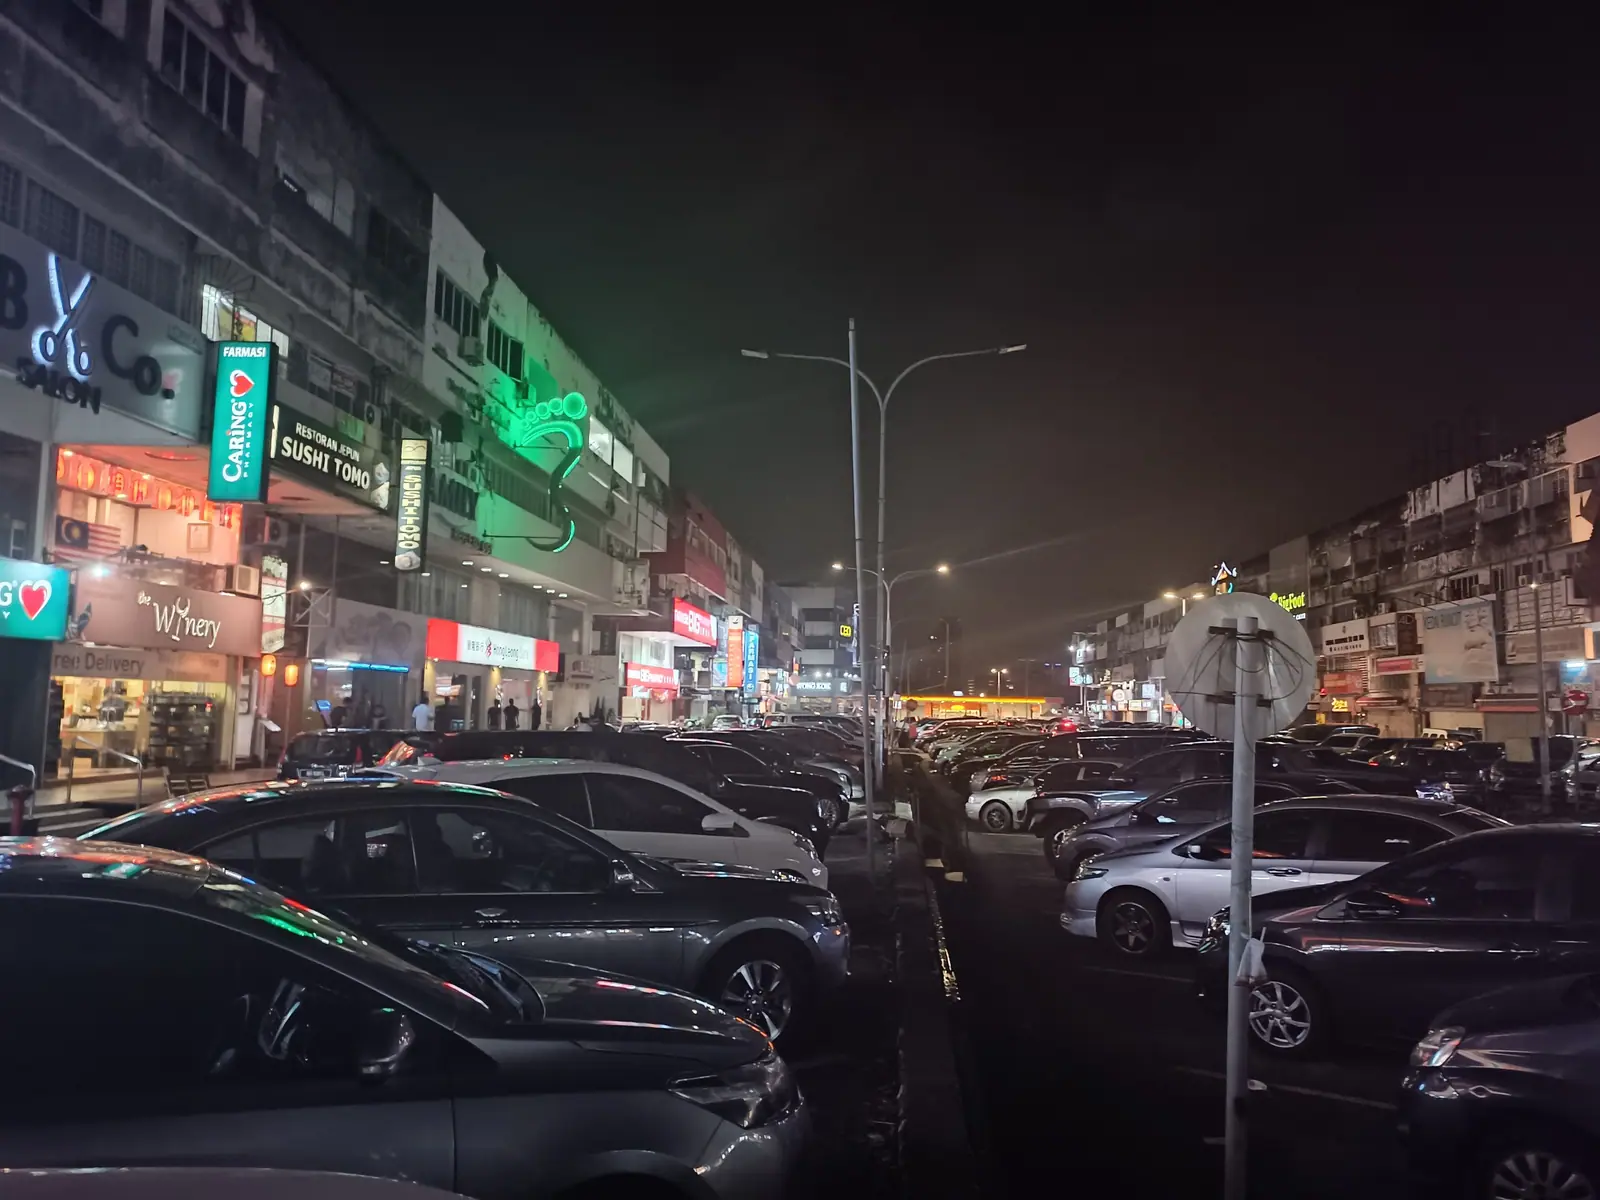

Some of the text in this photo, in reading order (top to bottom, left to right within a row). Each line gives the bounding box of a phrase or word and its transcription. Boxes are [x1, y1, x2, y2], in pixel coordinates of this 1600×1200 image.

[223, 347, 267, 358] FARMASI
[243, 402, 254, 478] PHARMACY
[295, 421, 360, 463] RESTORAN JEPUN
[281, 436, 370, 490] SUSHI TOMO
[401, 474, 422, 515] SUSHI
[398, 516, 421, 549] TOMO
[137, 590, 221, 649] the Winery
[53, 651, 80, 669] ree
[84, 651, 145, 678] Delivery
[747, 632, 756, 680] FARMASI
